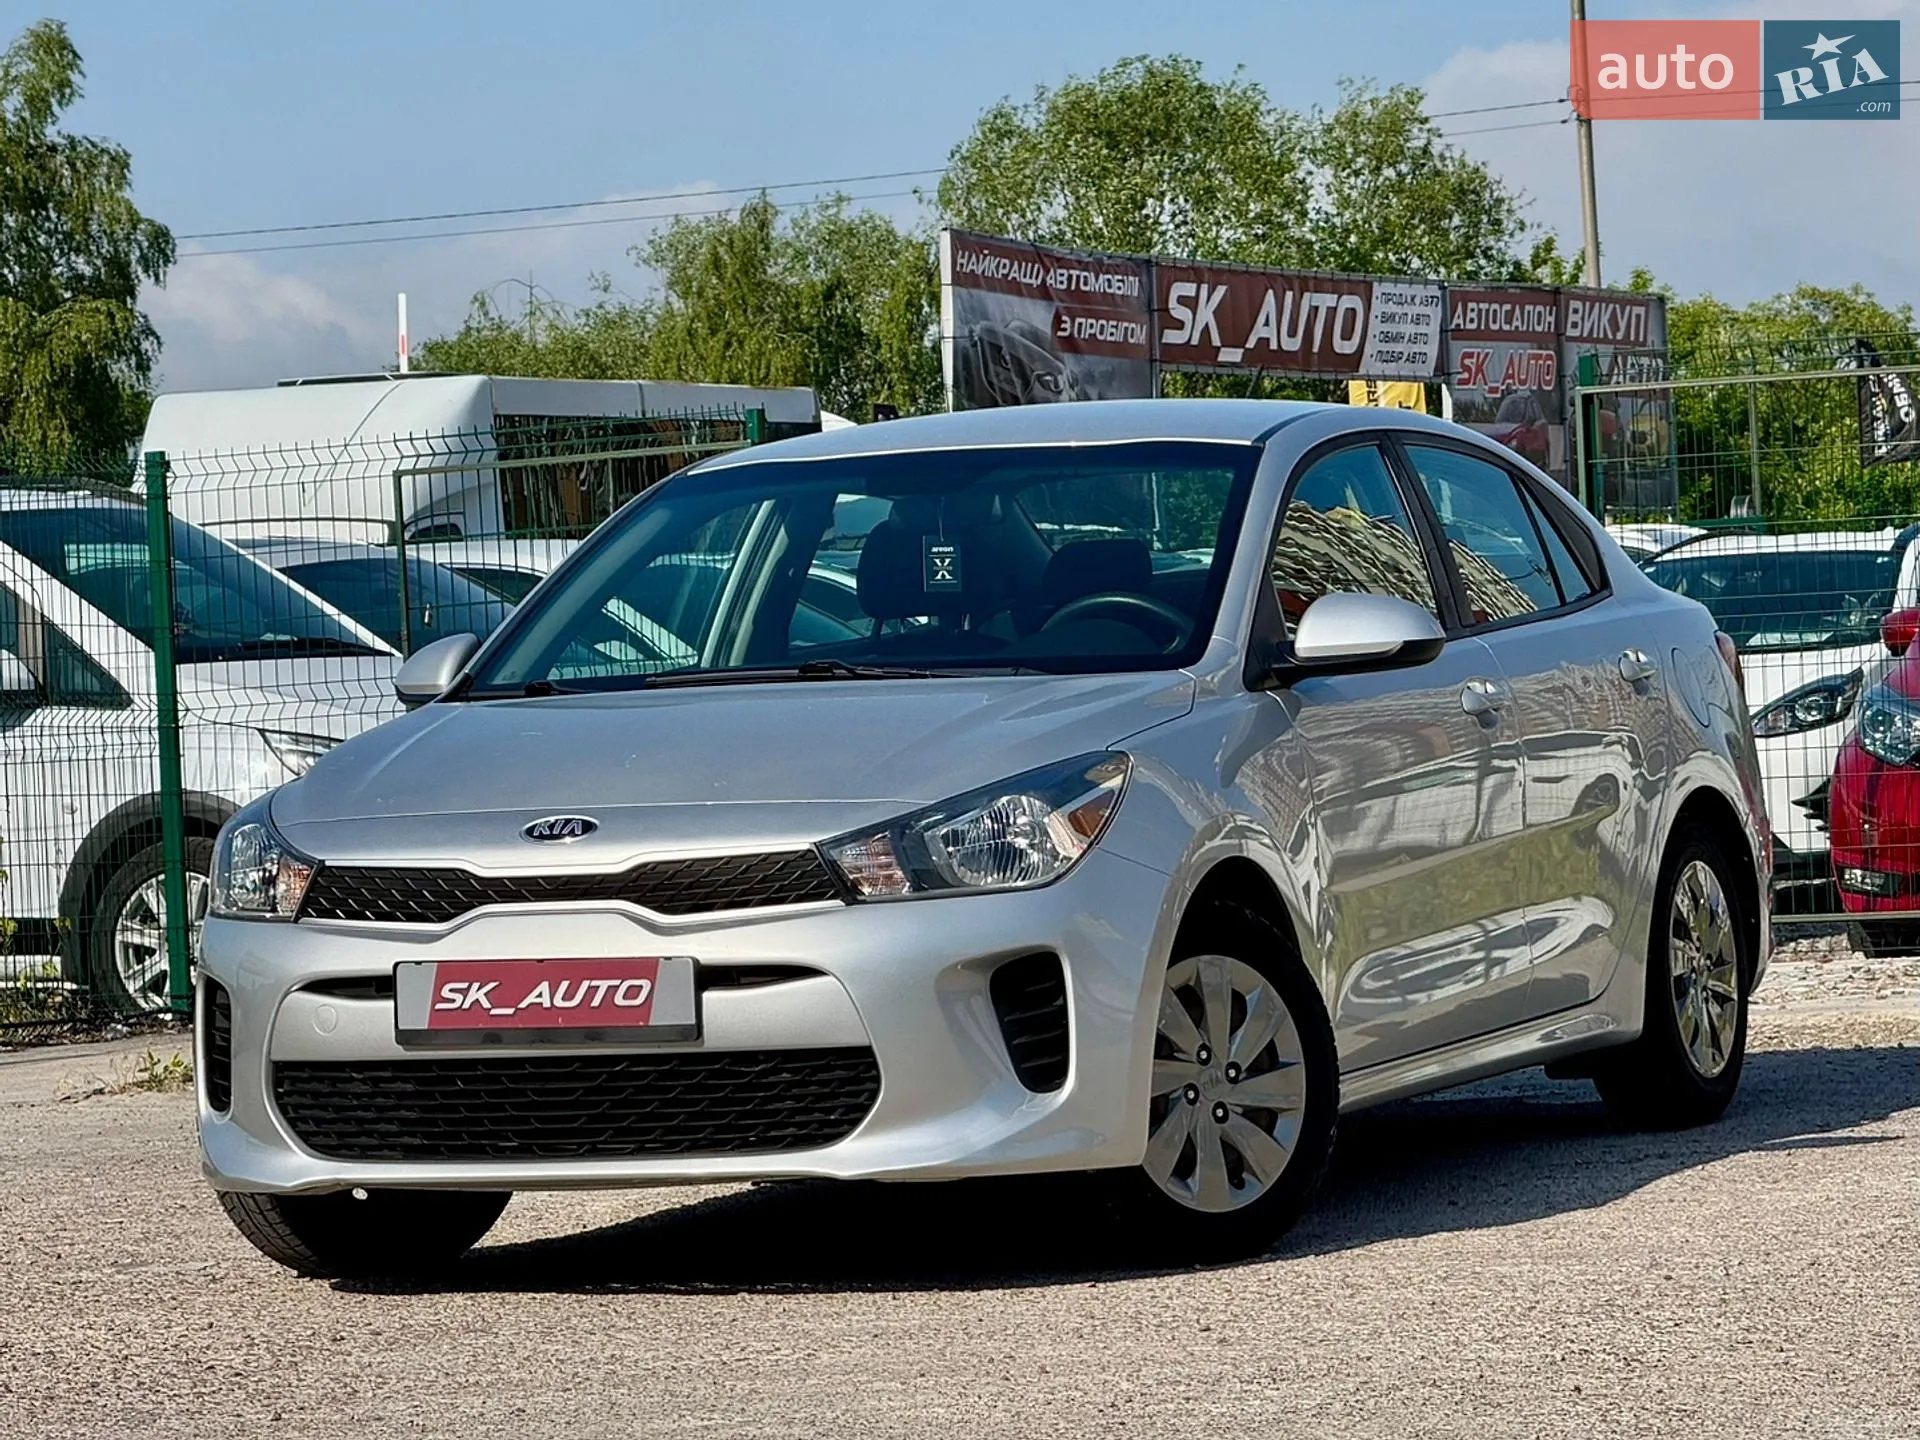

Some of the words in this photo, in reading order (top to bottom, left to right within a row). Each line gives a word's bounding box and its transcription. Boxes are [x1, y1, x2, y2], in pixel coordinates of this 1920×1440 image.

[956, 249, 1044, 288] НАЙКРАЩІ
[1046, 267, 1139, 297] АВТОМОБІЛІ
[1380, 292, 1417, 308] ПРОДАЖ
[1056, 315, 1071, 337] З
[1074, 317, 1147, 345] ПРОБІГОМ
[1161, 281, 1364, 363] SK_AUTO
[1380, 311, 1408, 325] ВИКУП
[1409, 313, 1431, 326] АВТО
[1451, 301, 1556, 333] АВТОСАЛОН
[1566, 299, 1646, 342] ВИКУП
[1378, 331, 1405, 344] ОБМІН
[1406, 332, 1429, 345] АВТО
[1375, 350, 1404, 364] ПІДБІР
[1404, 351, 1428, 364] АВТО
[1455, 348, 1558, 397] SK_AUTO
[533, 818, 583, 836] KIA
[434, 979, 652, 1016] SK_AUTO
